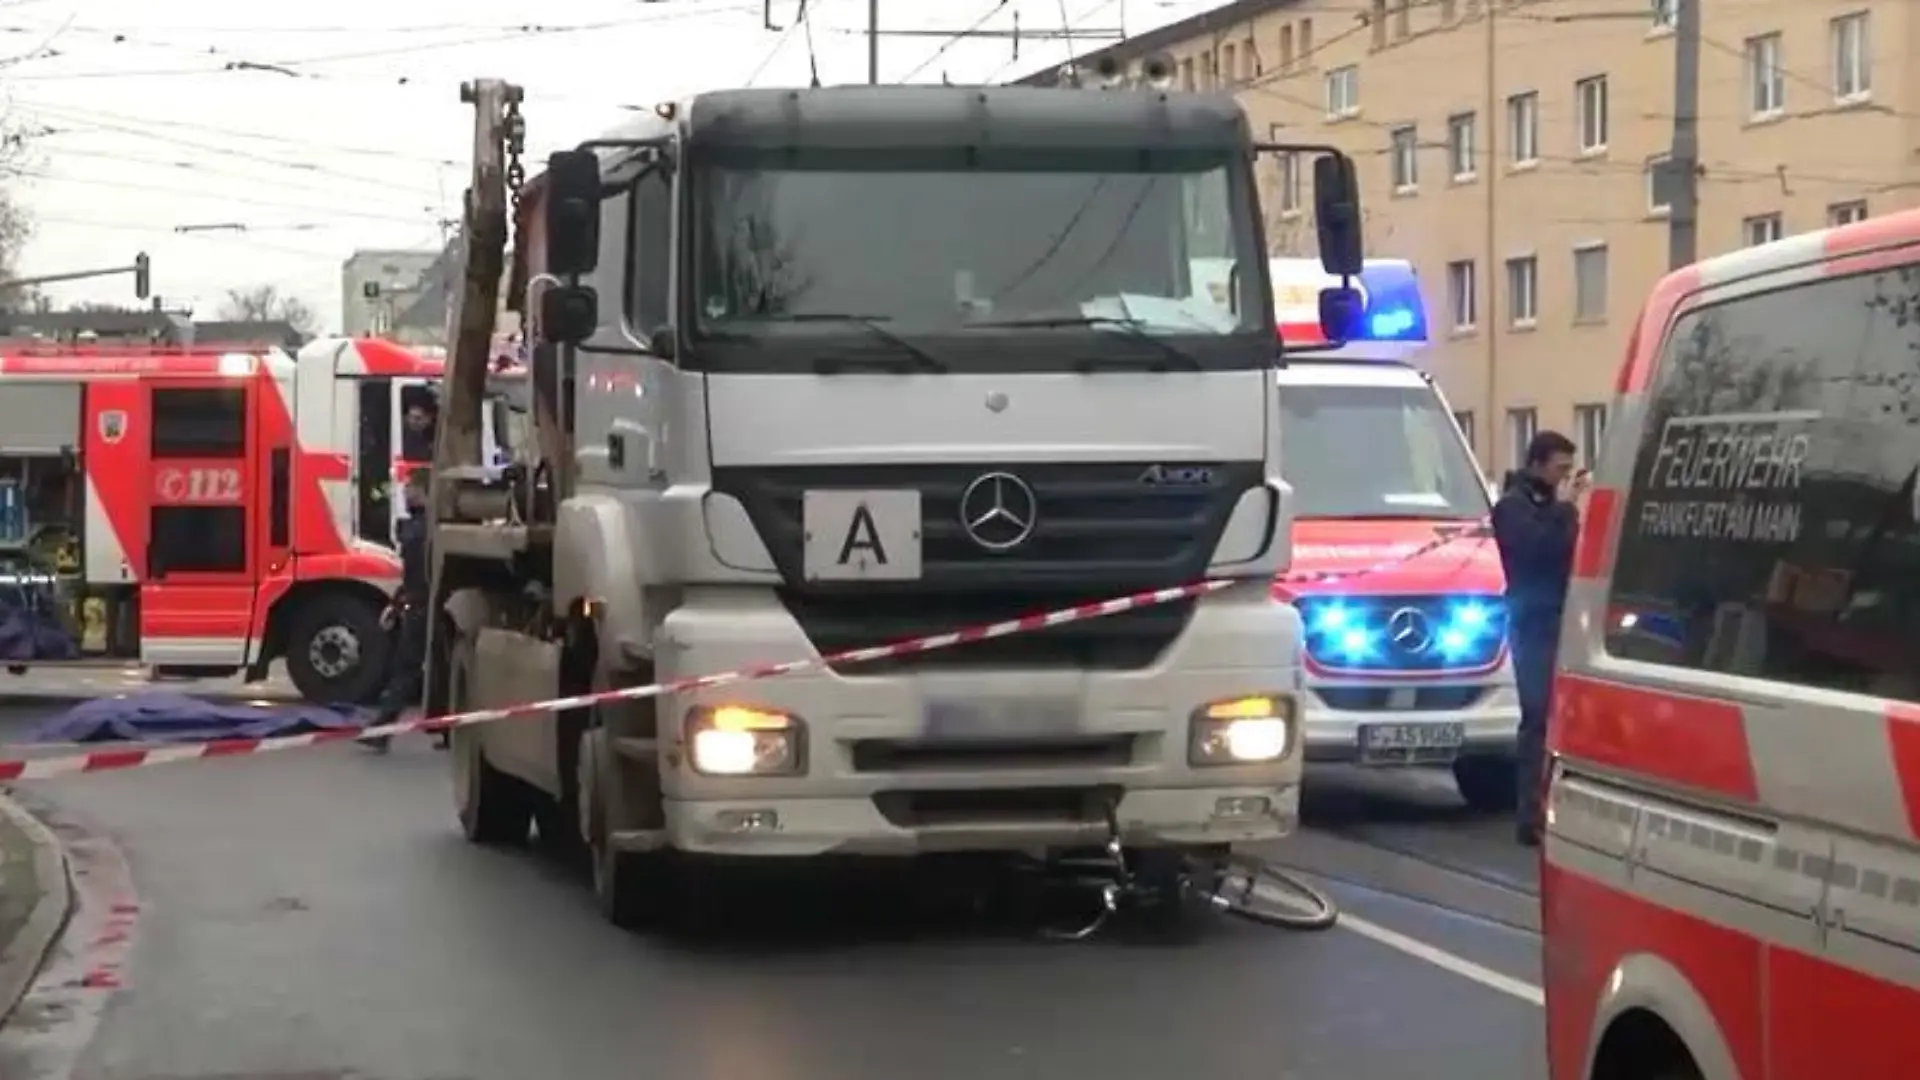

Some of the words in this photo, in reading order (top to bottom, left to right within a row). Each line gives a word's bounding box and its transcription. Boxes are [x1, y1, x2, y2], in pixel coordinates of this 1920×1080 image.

[1649, 410, 1820, 489] FEUERWEHR
[188, 466, 242, 501] 112
[836, 505, 888, 566] A
